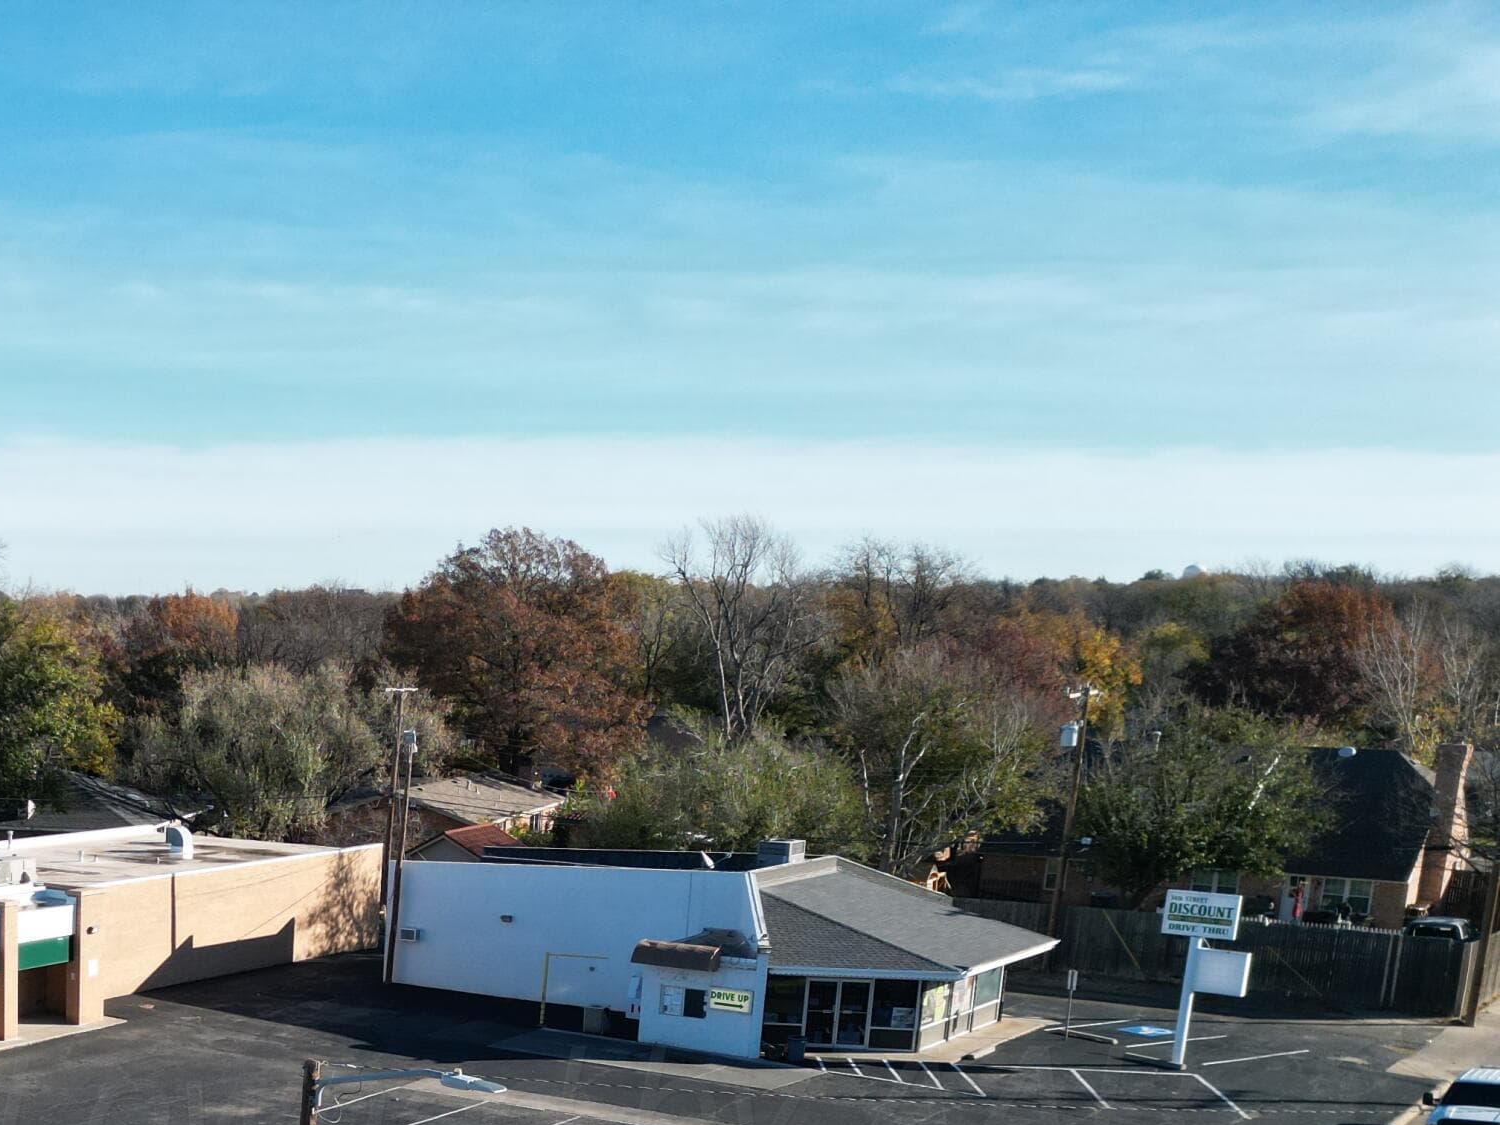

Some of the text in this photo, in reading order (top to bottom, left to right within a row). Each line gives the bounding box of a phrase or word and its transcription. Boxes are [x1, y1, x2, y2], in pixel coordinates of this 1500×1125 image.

[1169, 902, 1235, 918] DISCOUNT
[1168, 922, 1229, 935] DRIVE THRU
[710, 990, 749, 1003] DRIVE UP
